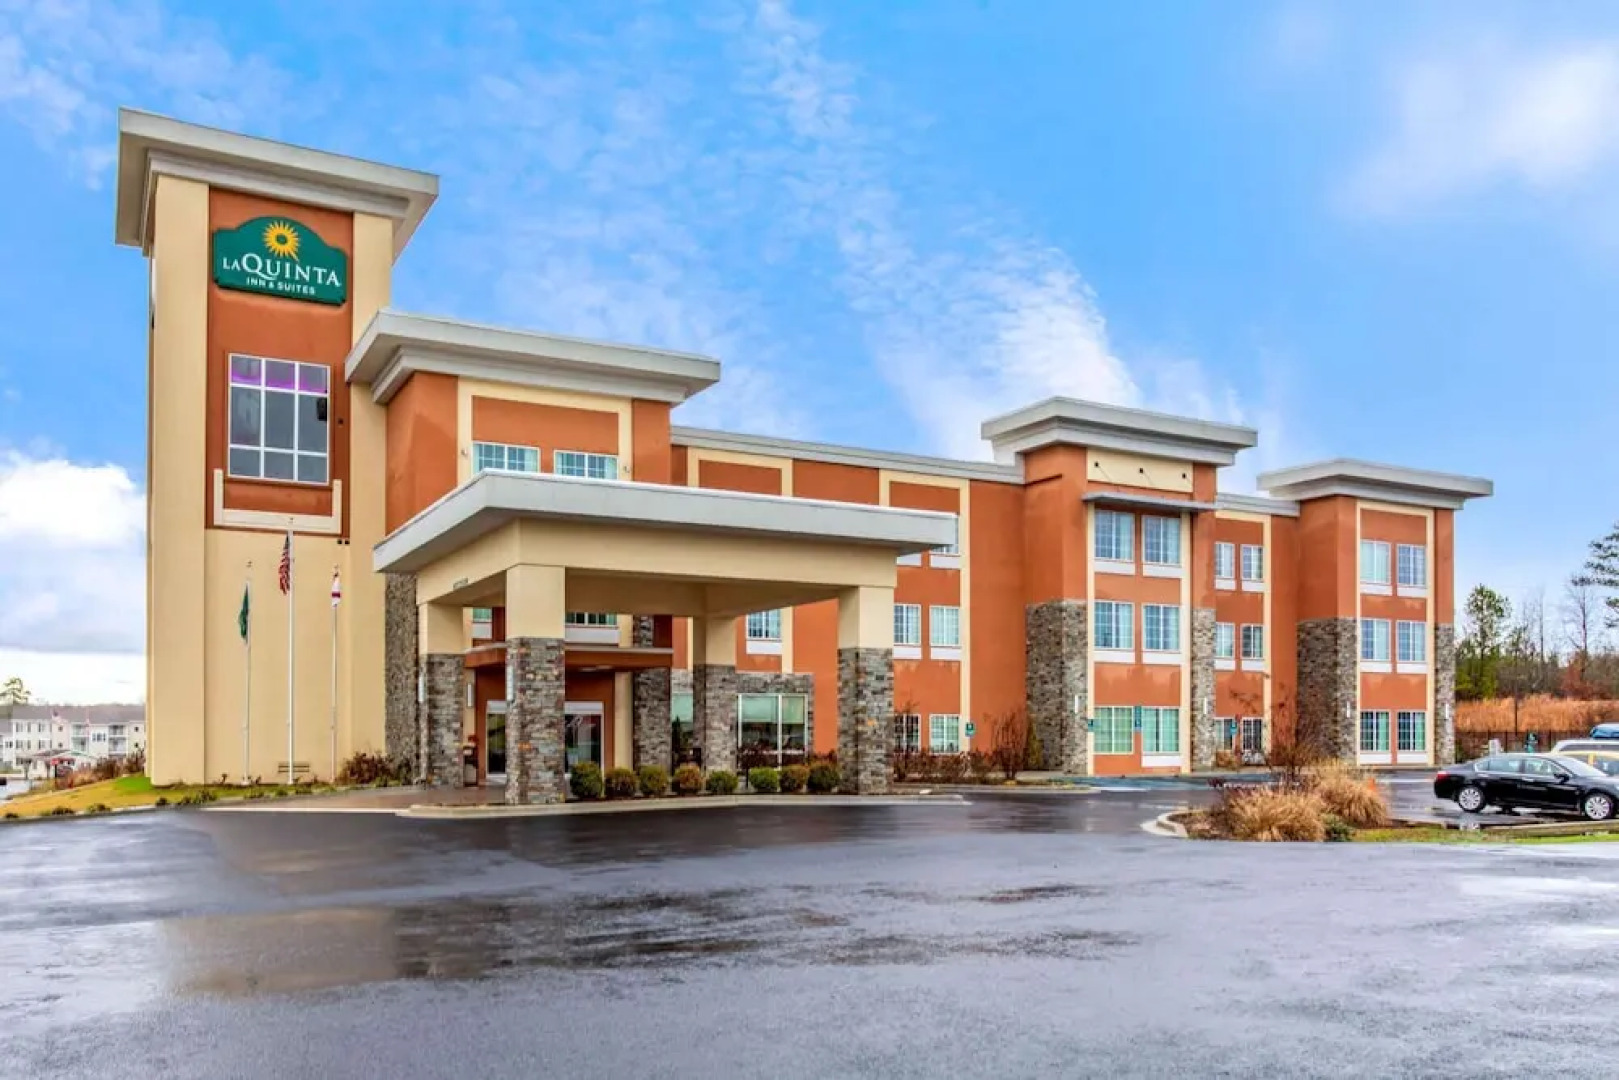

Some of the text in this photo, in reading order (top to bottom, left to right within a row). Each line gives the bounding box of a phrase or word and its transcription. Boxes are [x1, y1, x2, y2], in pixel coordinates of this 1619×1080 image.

[222, 252, 341, 287] LA QUINTA
[246, 277, 316, 295] INN & SUITES
